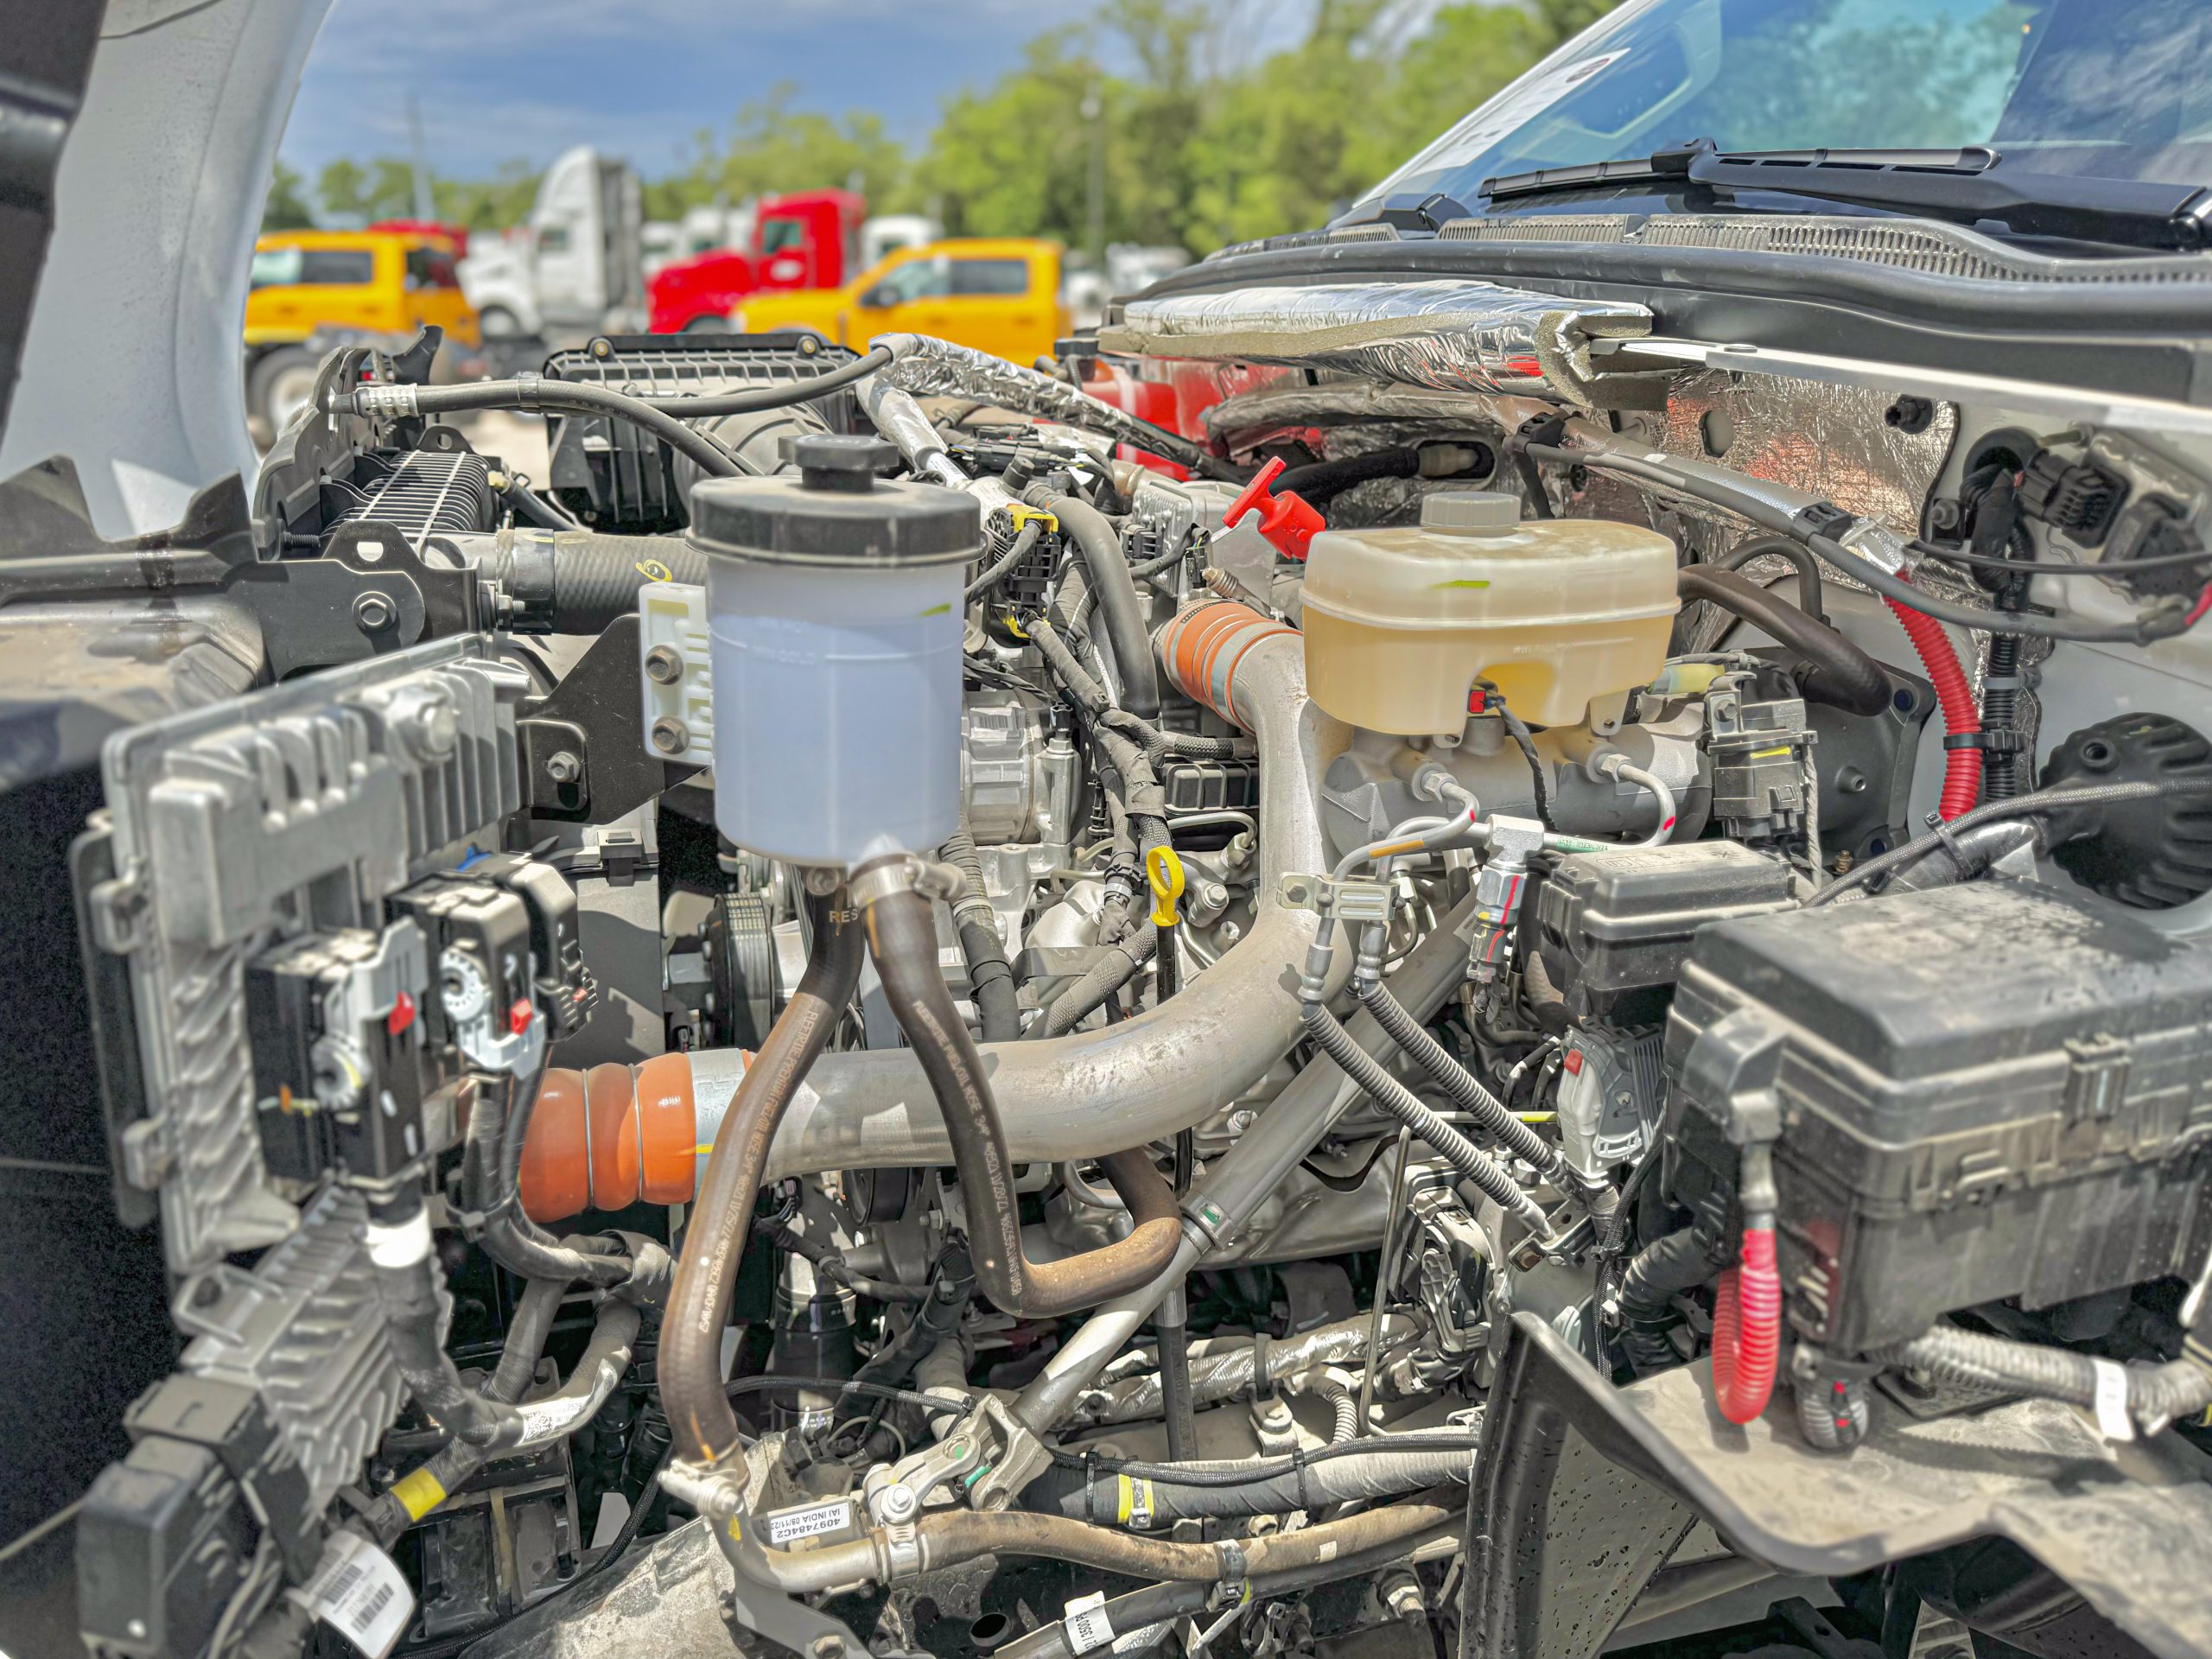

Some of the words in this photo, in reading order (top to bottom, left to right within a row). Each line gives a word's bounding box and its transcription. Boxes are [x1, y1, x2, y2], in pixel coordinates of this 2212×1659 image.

[802, 1510, 827, 1523] INDIA
[829, 1507, 841, 1518] IAI
[777, 1518, 841, 1539] 4097484C2
[1077, 1618, 1093, 1638] 3500
